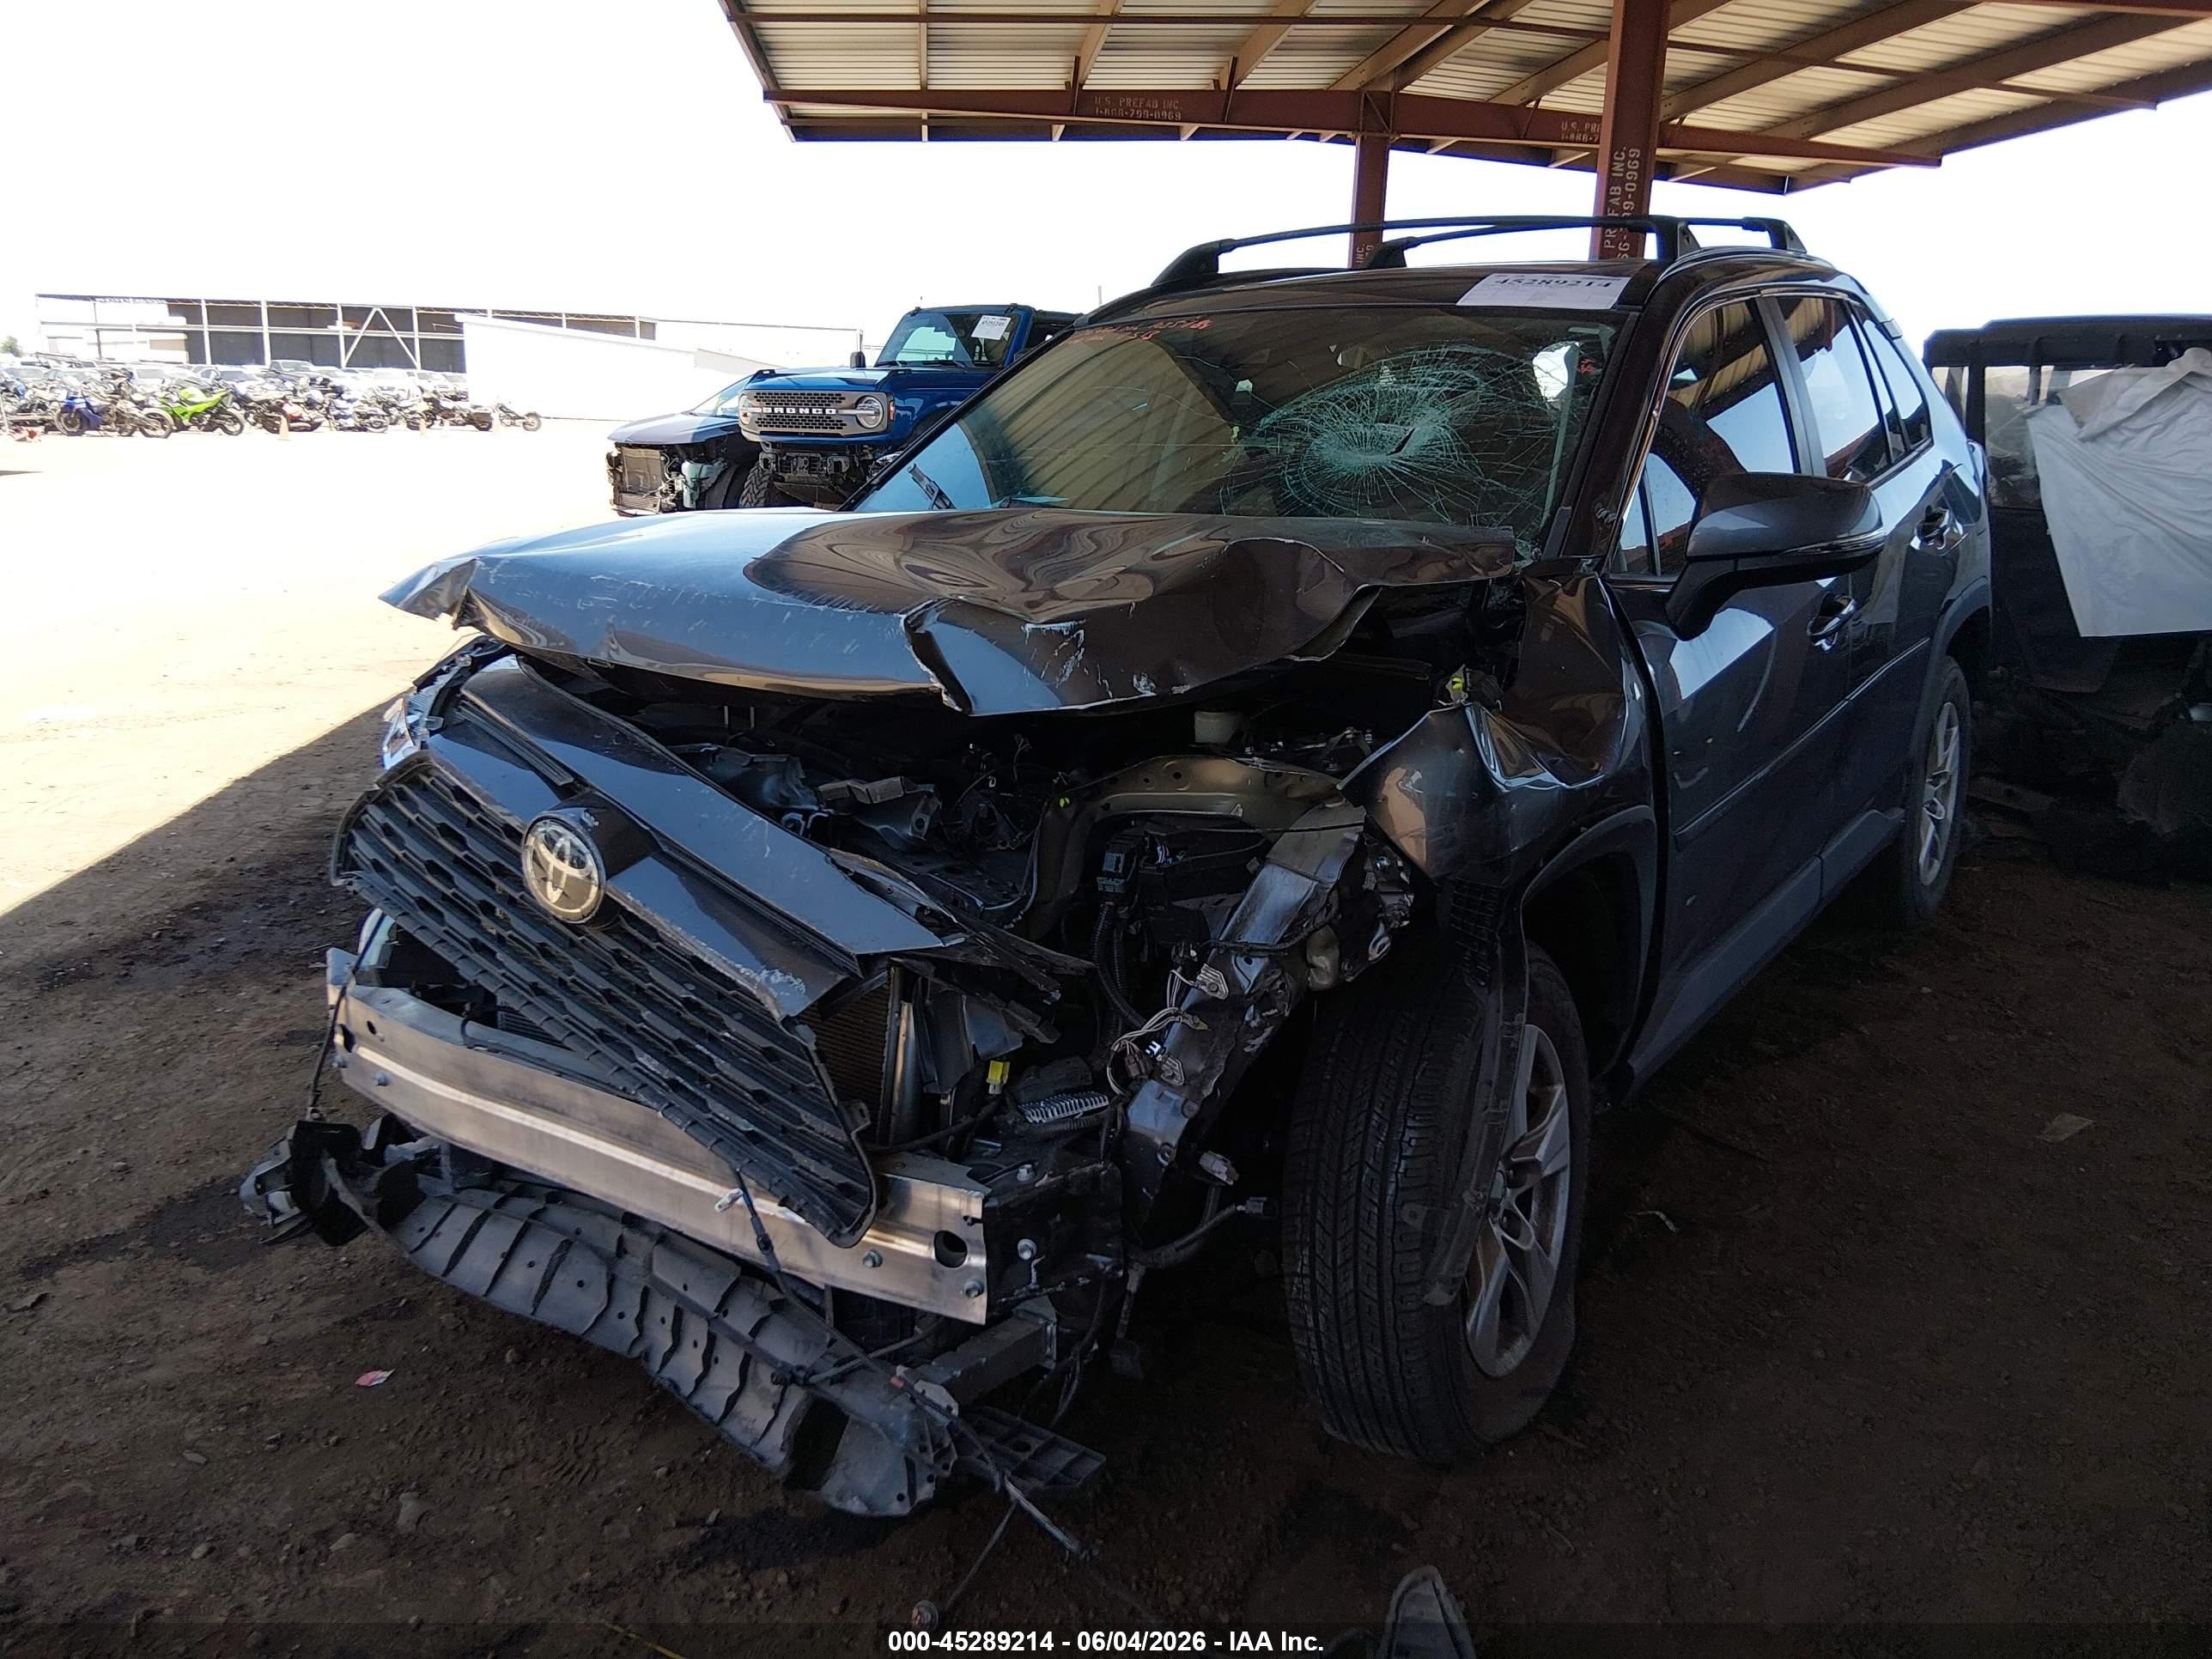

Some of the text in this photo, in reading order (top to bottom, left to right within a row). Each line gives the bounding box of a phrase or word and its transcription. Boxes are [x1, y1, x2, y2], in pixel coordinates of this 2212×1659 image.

[1119, 96, 1158, 109] PREFAB
[1603, 146, 1627, 248] PRFAB INC.
[762, 406, 837, 415] BRONCO
